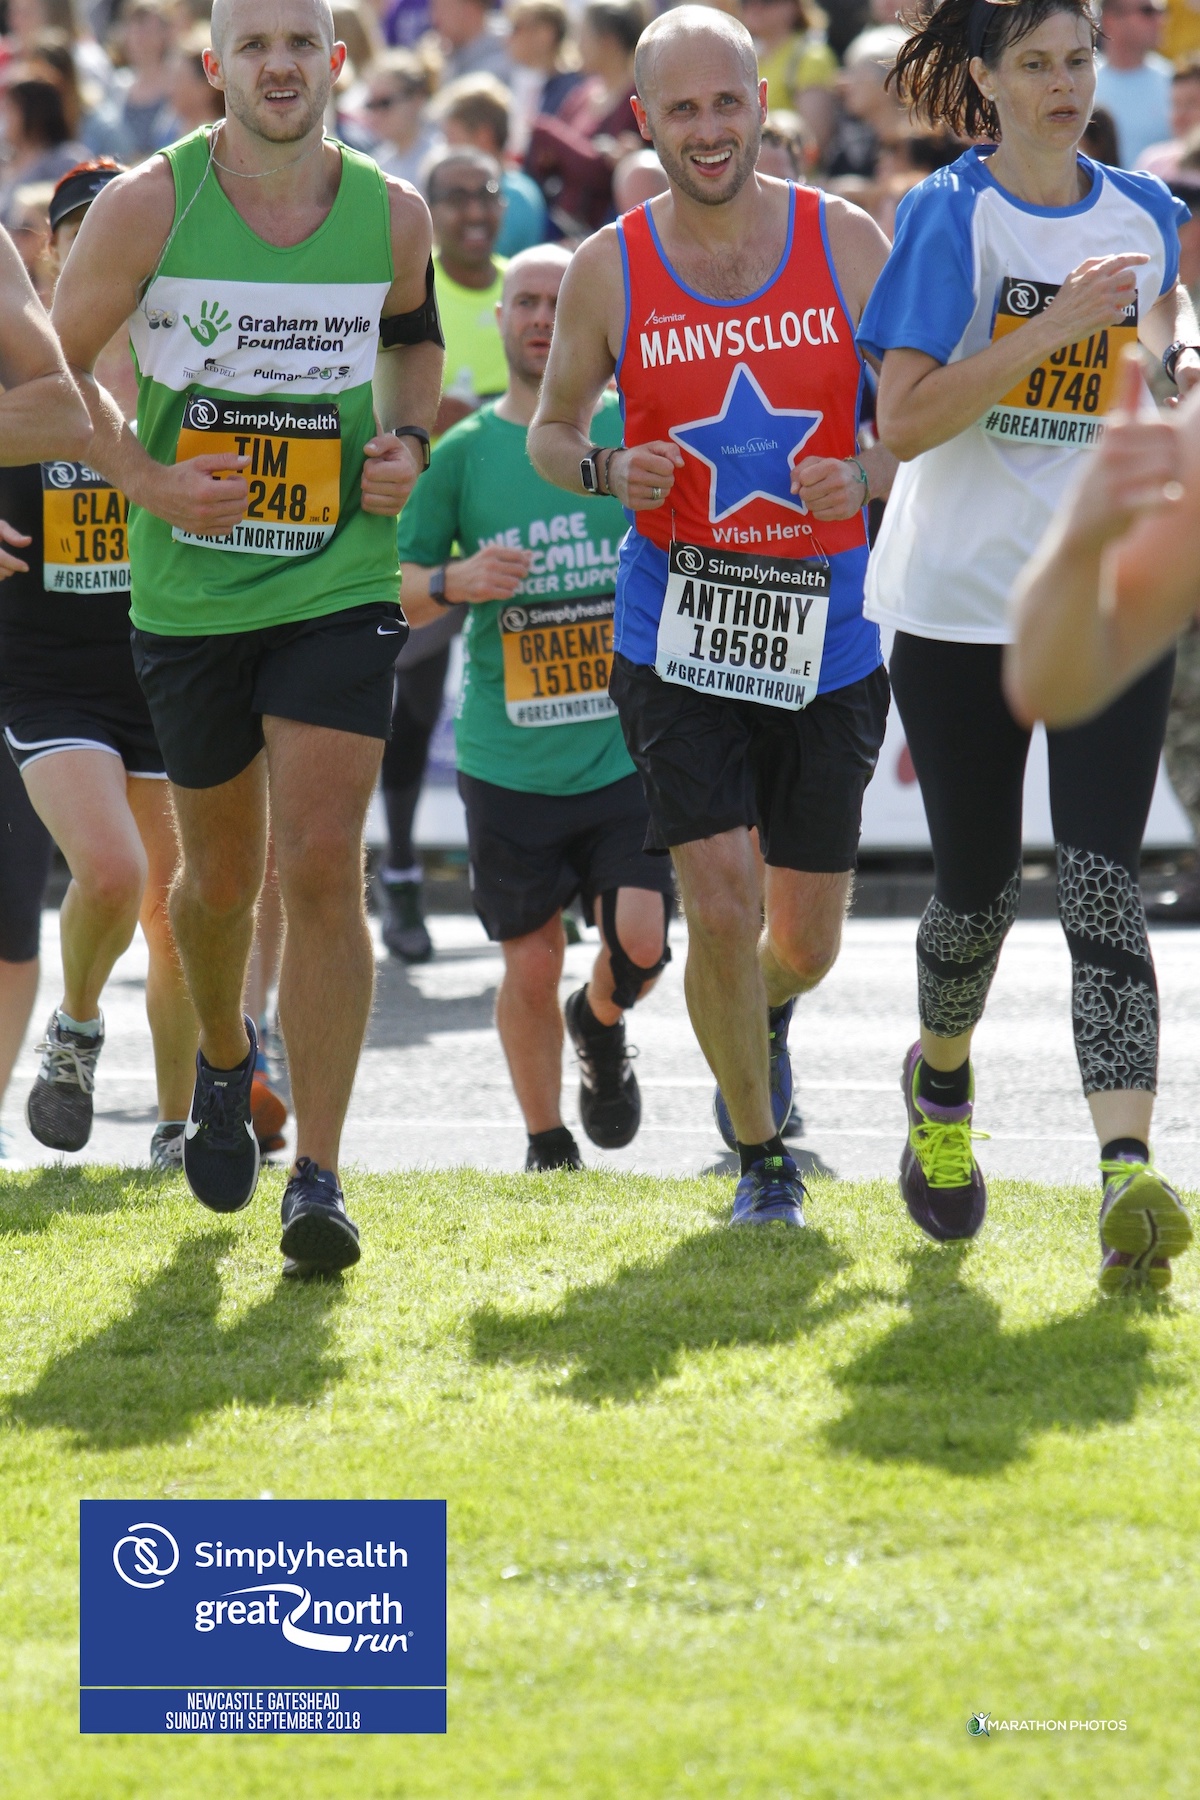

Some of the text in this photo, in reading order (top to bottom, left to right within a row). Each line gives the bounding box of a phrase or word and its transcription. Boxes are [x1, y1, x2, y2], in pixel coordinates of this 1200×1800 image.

[237, 314, 371, 337] Graham Wylie
[652, 313, 687, 325] Scimitar
[237, 334, 344, 353] Foundation
[640, 307, 840, 369] MANVSCLOCK
[1049, 330, 1109, 369] LIA
[1025, 367, 1102, 413] 9748
[223, 410, 338, 431] Simplyhealth
[234, 436, 289, 478] TIM
[720, 444, 746, 455] Make
[756, 439, 779, 452] Wish
[322, 506, 330, 522] C
[528, 512, 588, 547] ARE
[75, 528, 129, 563] 163
[712, 522, 813, 544] Wish Hero
[708, 559, 826, 588] Simplyhealth
[677, 580, 814, 635] ANTHONY
[520, 624, 611, 664] GRAEME
[689, 624, 789, 673] 19588
[530, 659, 609, 697] 15168
[666, 660, 806, 705] #GREATNORTHRUN
[803, 661, 812, 677] E
